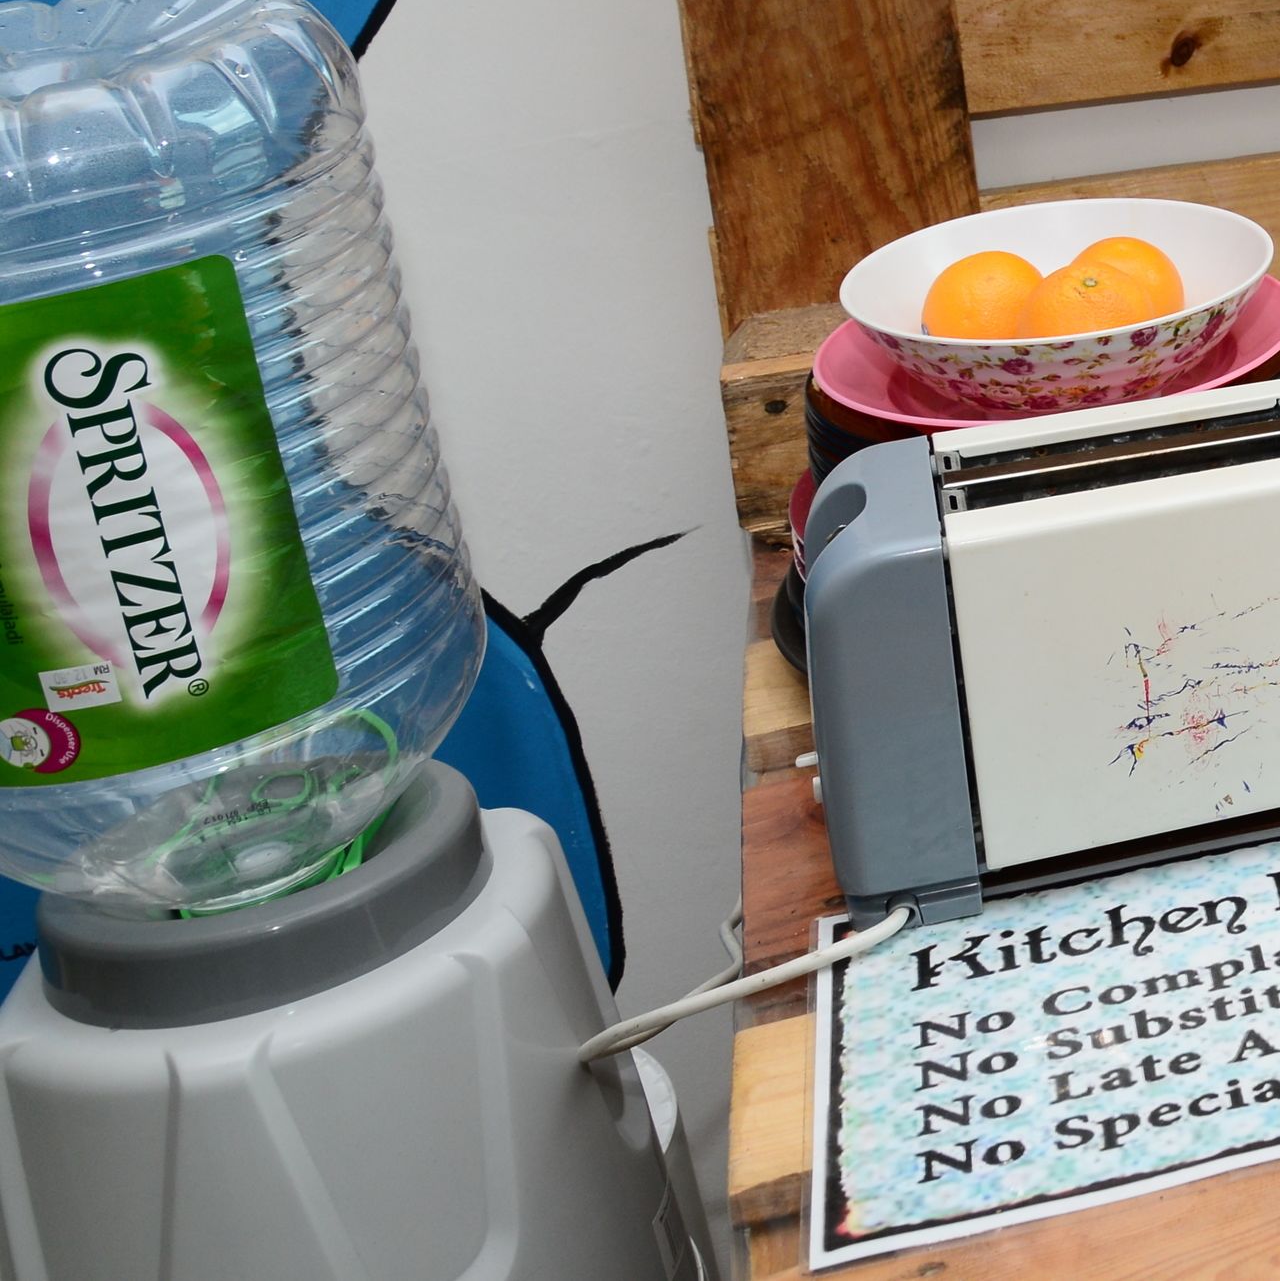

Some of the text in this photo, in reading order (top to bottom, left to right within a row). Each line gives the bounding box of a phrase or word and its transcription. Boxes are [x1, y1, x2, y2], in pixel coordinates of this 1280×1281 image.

[93, 663, 111, 676] RM
[45, 712, 76, 764] Dispenser Use
[910, 893, 1248, 992] Kitchen
[914, 1010, 1016, 1050] No
[914, 1049, 1019, 1091] No
[915, 1092, 1022, 1137] No
[1049, 1048, 1202, 1105] Late
[916, 1140, 1026, 1184] No
